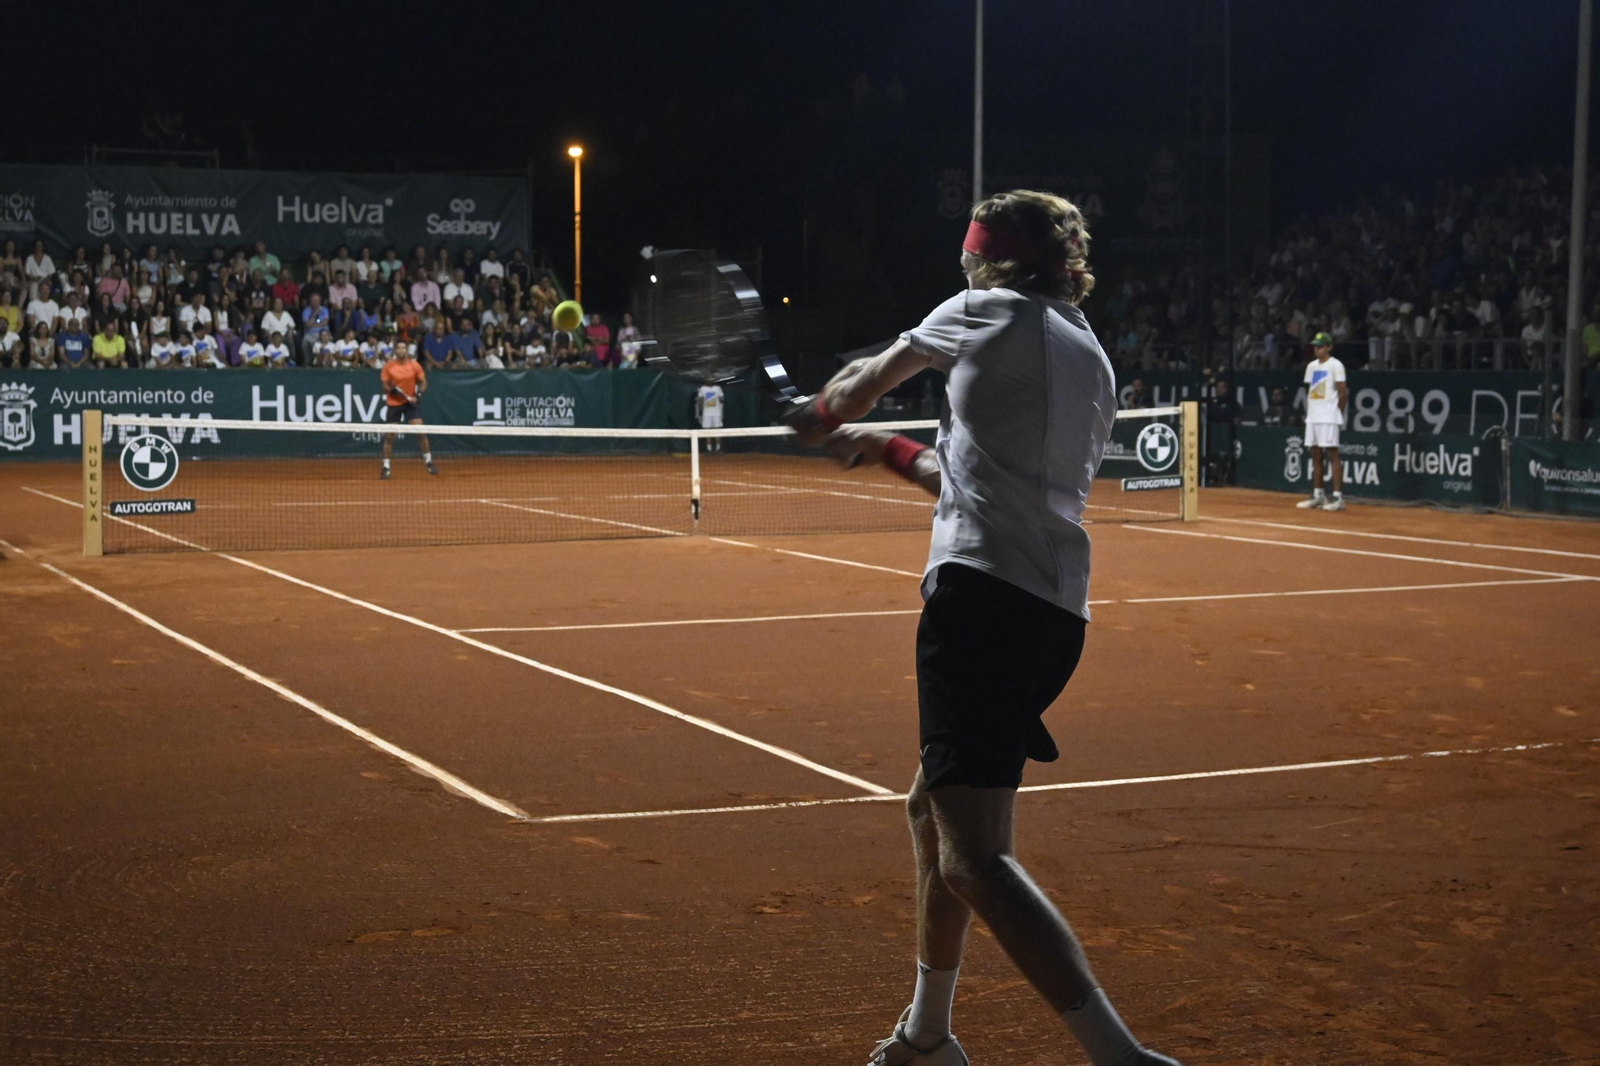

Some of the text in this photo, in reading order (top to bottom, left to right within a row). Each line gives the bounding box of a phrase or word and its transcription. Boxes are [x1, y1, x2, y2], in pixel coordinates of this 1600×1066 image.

[124, 194, 238, 208] Ayuntamiento de
[276, 195, 384, 224] Huelva
[126, 212, 242, 236] HUELVA
[426, 212, 501, 241] Seabery
[50, 386, 215, 409] Ayuntamiento de
[505, 394, 575, 407] DIPUTACIÓN
[505, 407, 574, 419] DE HUELVA
[1366, 443, 1379, 457] de
[1393, 443, 1472, 477] Huelva
[1188, 431, 1196, 493] HUELVA
[1307, 458, 1380, 485] ULVA
[88, 446, 98, 522] HUELVA
[1126, 478, 1181, 490] AUTOGOTRAN
[1442, 480, 1472, 493] original
[114, 501, 191, 514] AUTOGOTRAN
